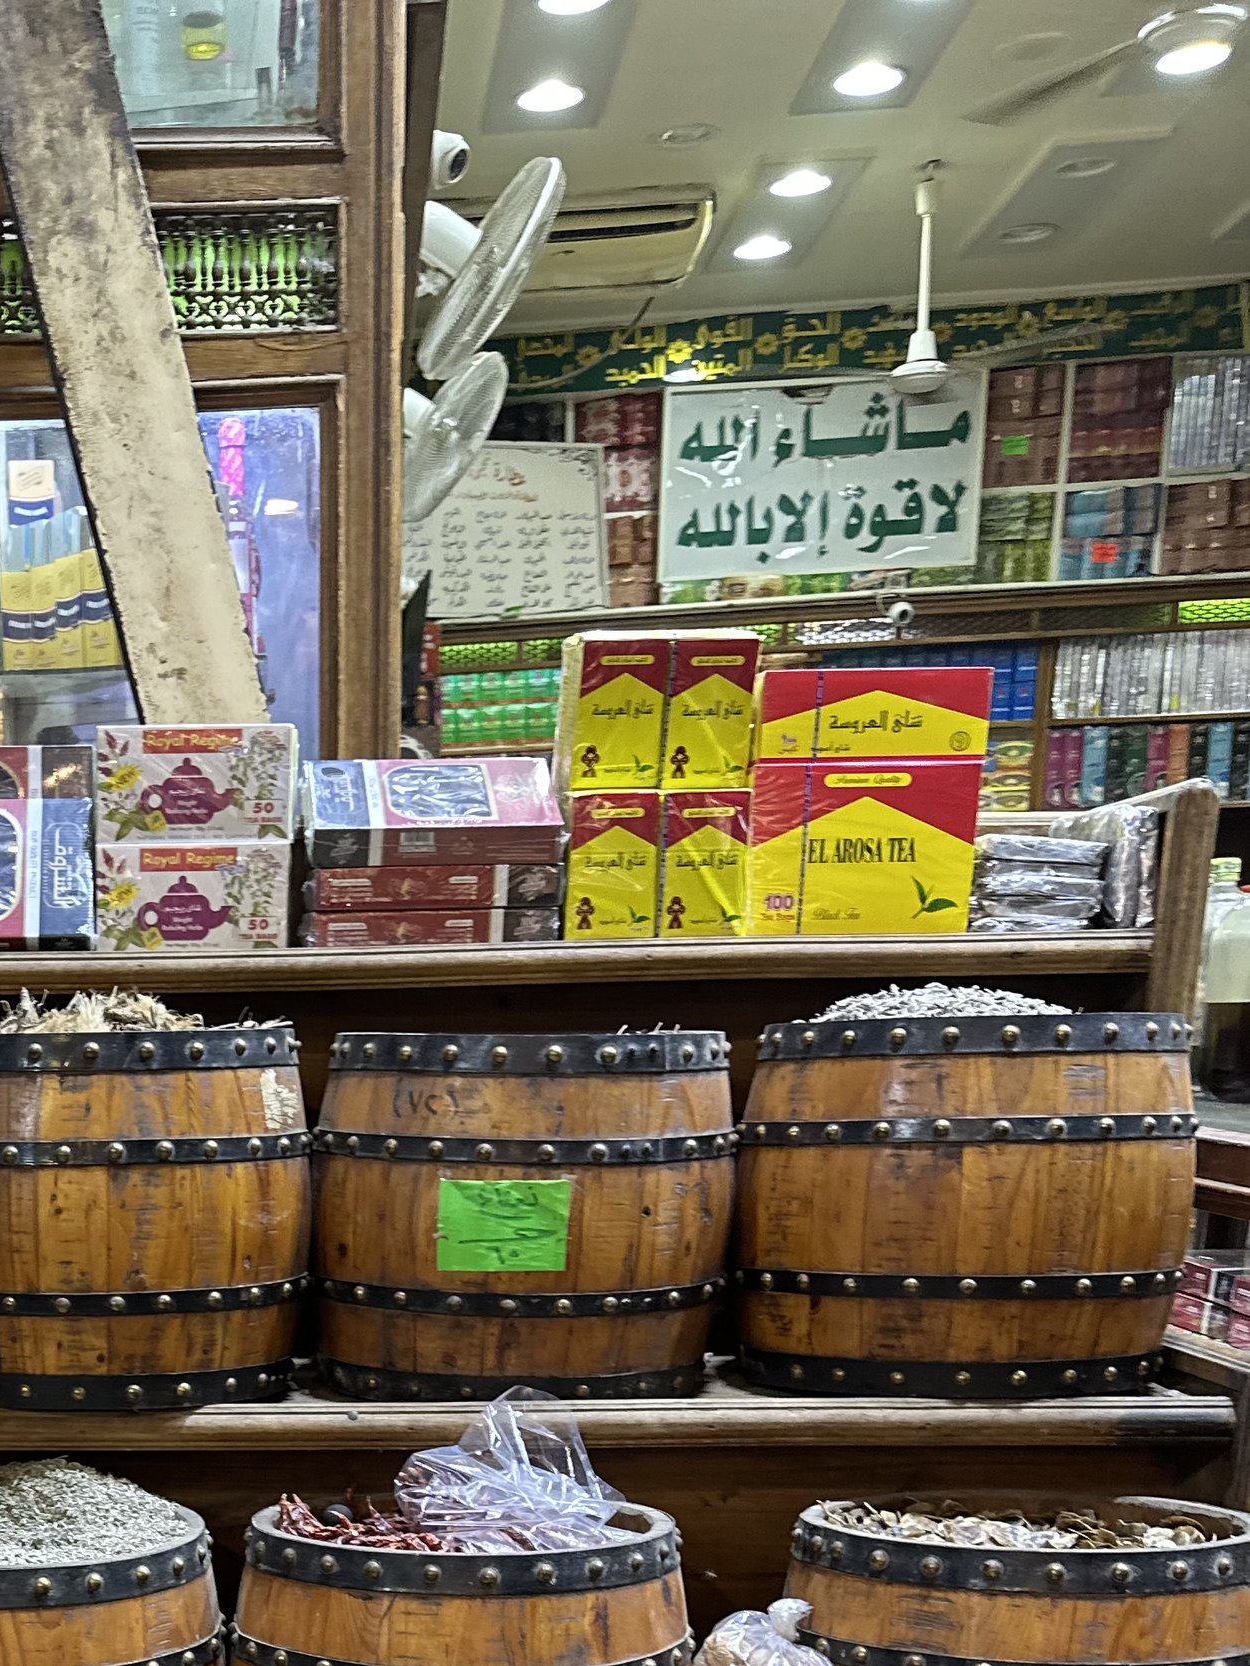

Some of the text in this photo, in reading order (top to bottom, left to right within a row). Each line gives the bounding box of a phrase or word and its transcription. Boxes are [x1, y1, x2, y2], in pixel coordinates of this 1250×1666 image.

[679, 406, 760, 463] الله
[838, 478, 924, 554] قوة
[676, 495, 774, 564] بالله
[829, 709, 890, 734] العروسة
[253, 802, 275, 814] 50
[141, 852, 236, 868] Royal Regime
[808, 837, 916, 864] EL AROSA TEA
[762, 893, 795, 912] 100
[249, 918, 270, 931] 50
